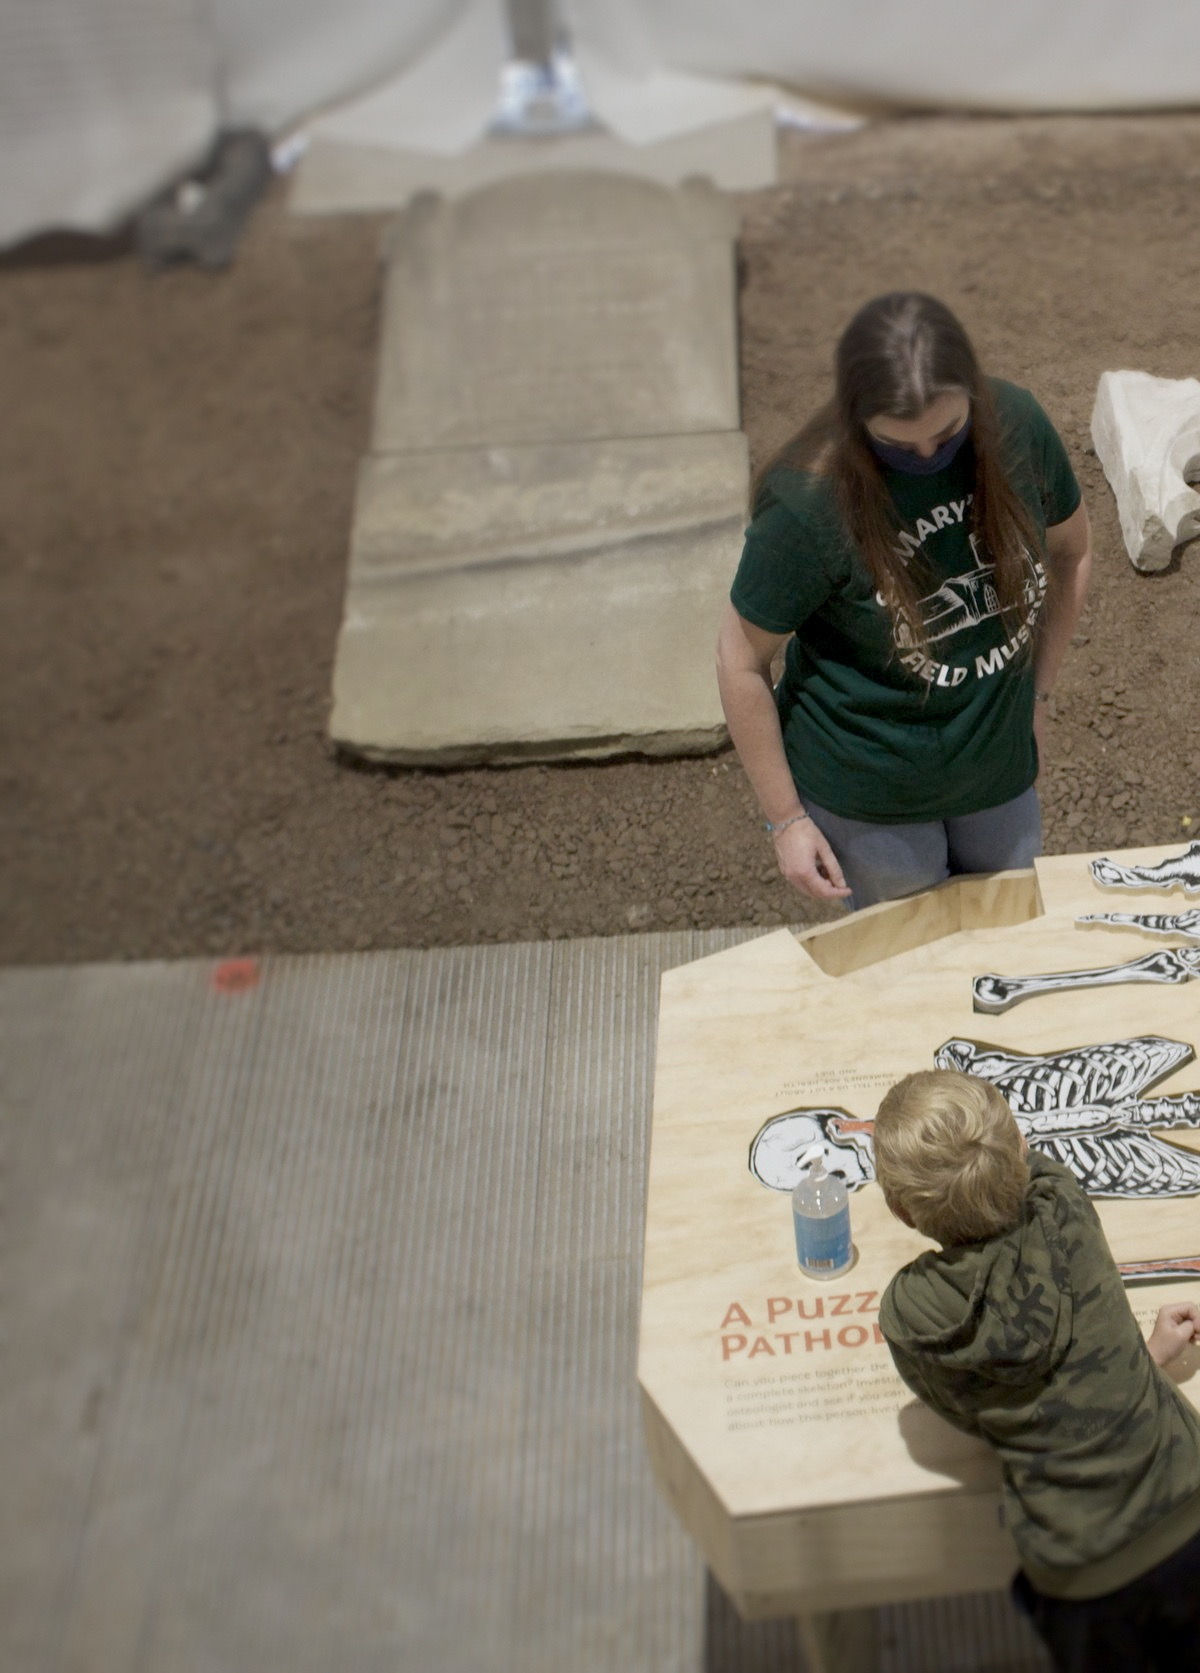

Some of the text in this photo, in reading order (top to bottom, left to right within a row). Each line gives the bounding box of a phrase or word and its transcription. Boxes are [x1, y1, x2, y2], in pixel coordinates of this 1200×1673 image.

[893, 494, 974, 567] MARY'
[900, 651, 968, 687] FIELD
[720, 1290, 880, 1329] A PUZZ
[721, 1321, 887, 1361] PATHOL
[857, 1375, 903, 1388] Investig
